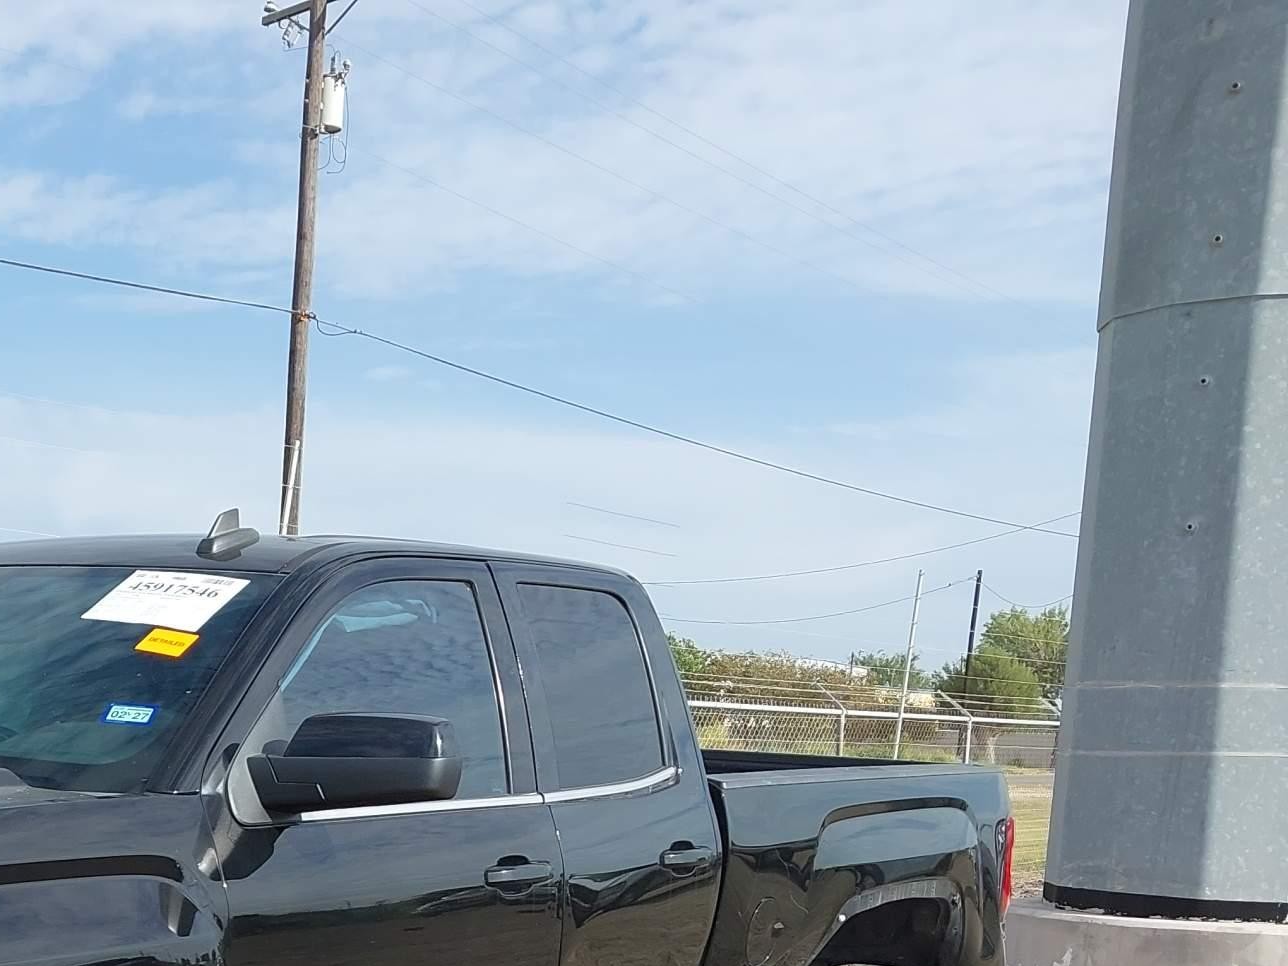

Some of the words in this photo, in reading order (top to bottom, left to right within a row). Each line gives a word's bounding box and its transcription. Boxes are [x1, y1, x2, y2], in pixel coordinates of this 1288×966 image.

[128, 581, 219, 598] 45917546
[111, 710, 127, 719] 02
[131, 712, 150, 720] 27
